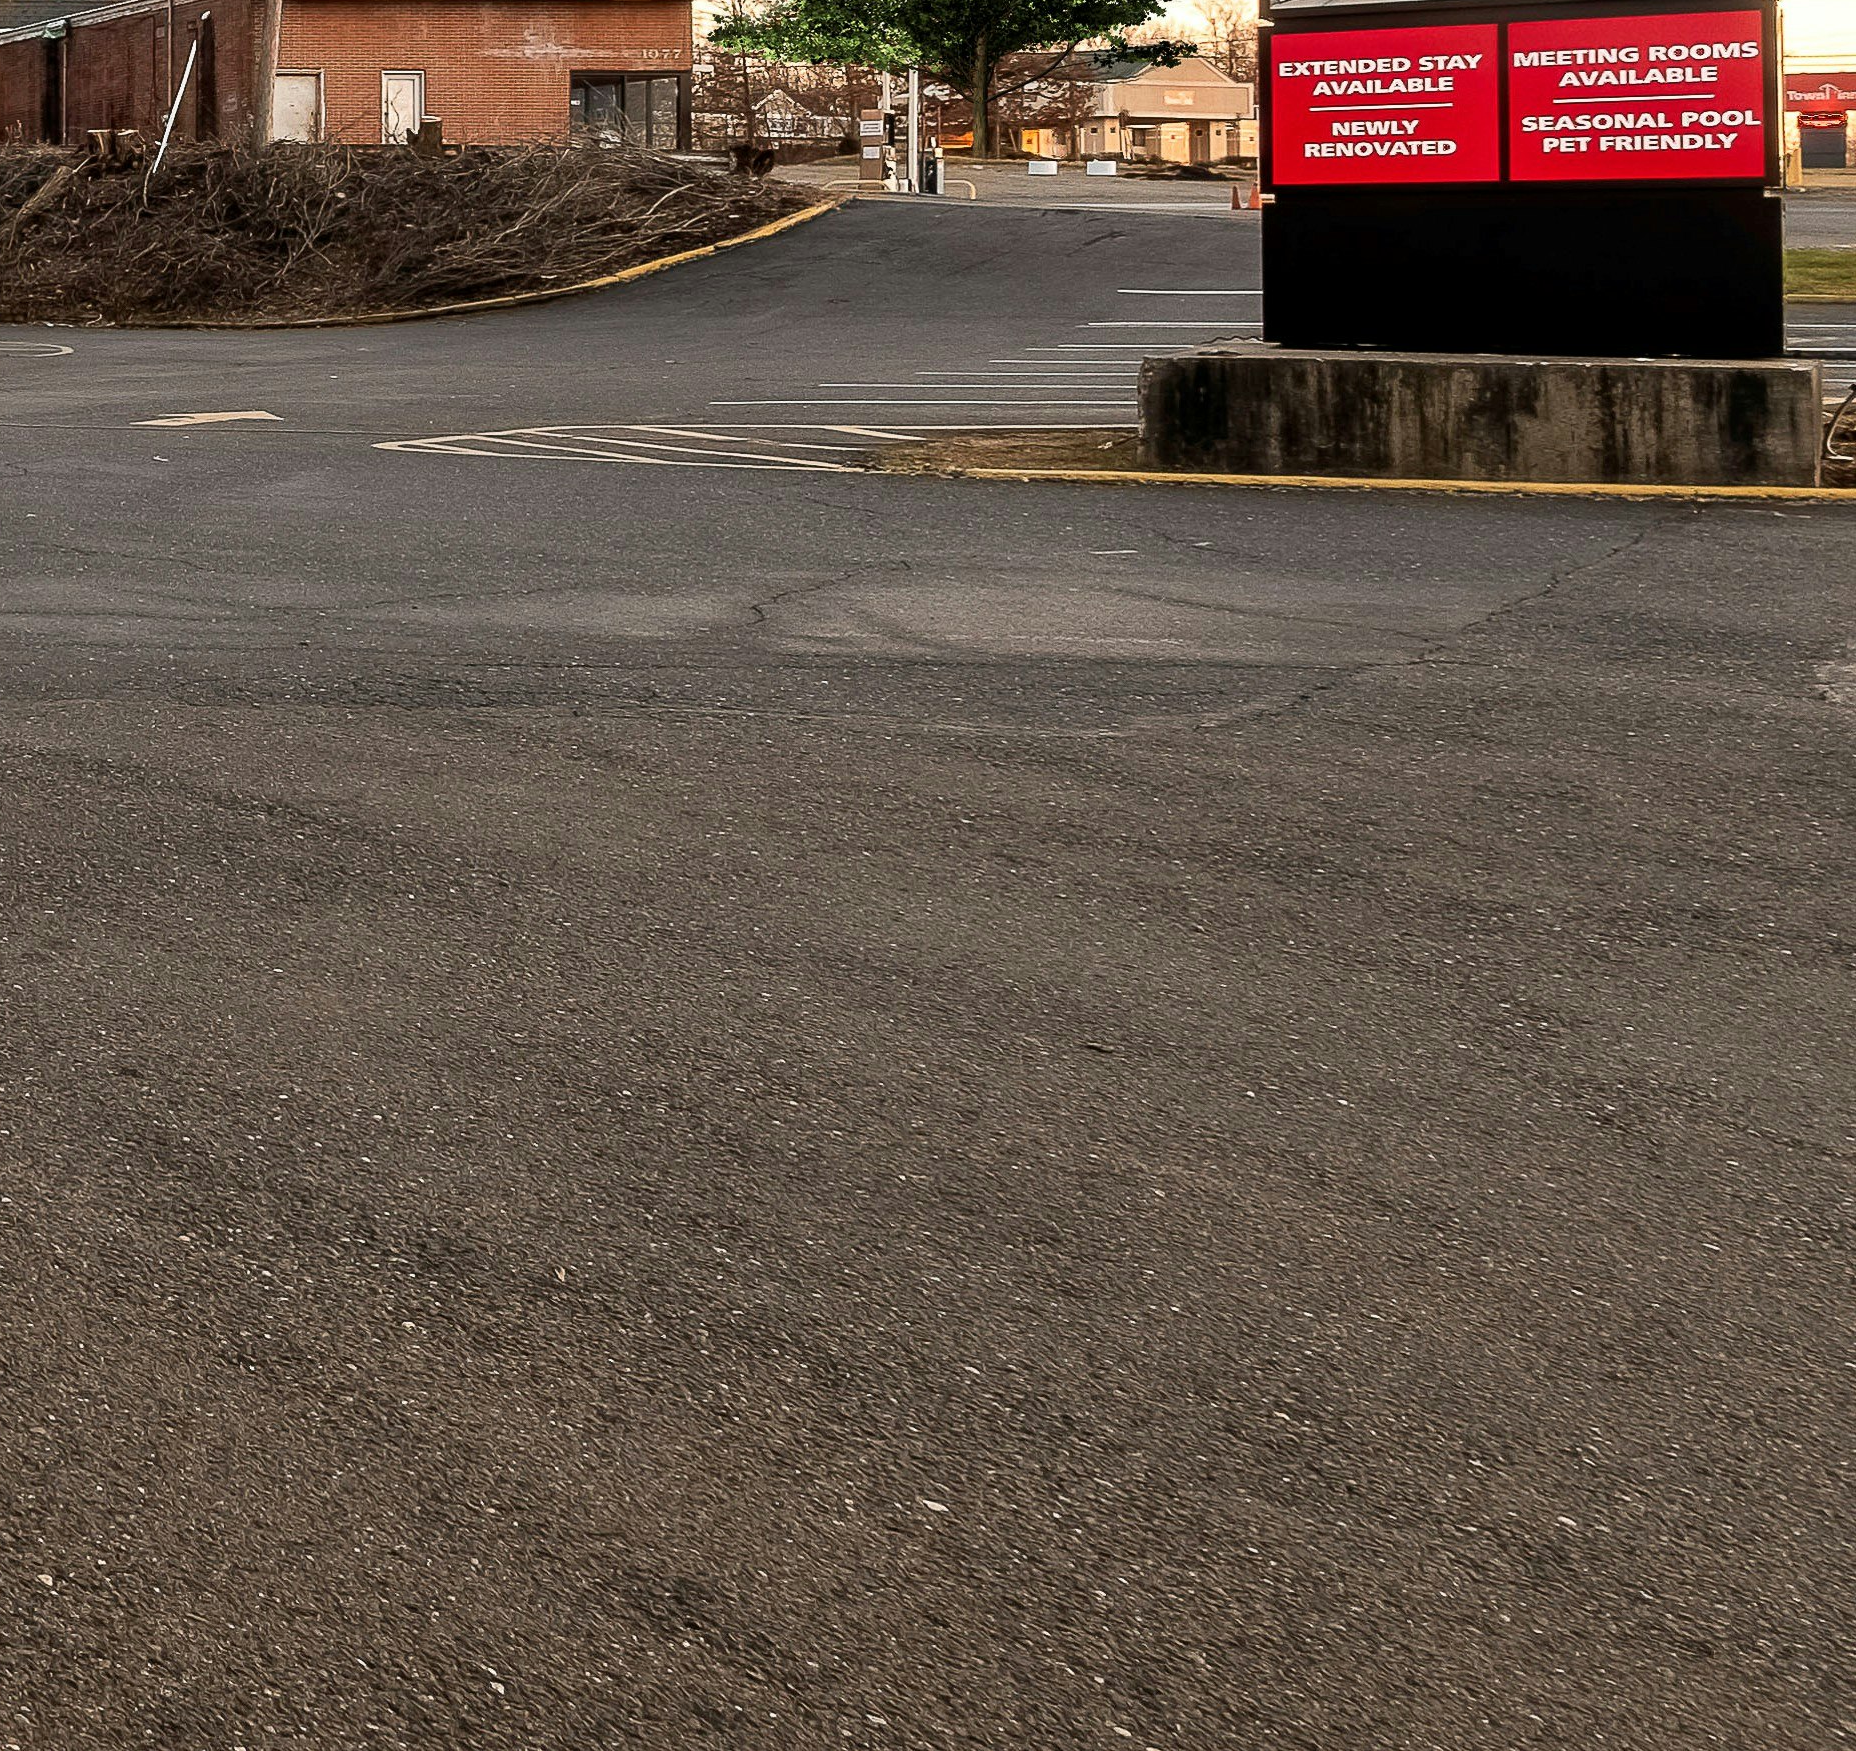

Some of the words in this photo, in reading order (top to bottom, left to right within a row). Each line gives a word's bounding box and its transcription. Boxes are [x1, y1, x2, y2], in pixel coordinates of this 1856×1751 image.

[1278, 57, 1412, 77] EXTENDED
[1418, 53, 1483, 71] STAY
[1512, 47, 1640, 68] MEETING
[1648, 41, 1760, 62] ROOMS
[1312, 76, 1455, 97] AVAILABLE
[1558, 66, 1719, 88] AVAILABLE
[1331, 119, 1420, 137] NEWLY
[1521, 112, 1674, 133] SEASONAL
[1681, 109, 1762, 128] POOL
[1304, 140, 1458, 158] RENOVATED
[1543, 135, 1593, 154] PET
[1599, 132, 1739, 152] FRIENDLY
